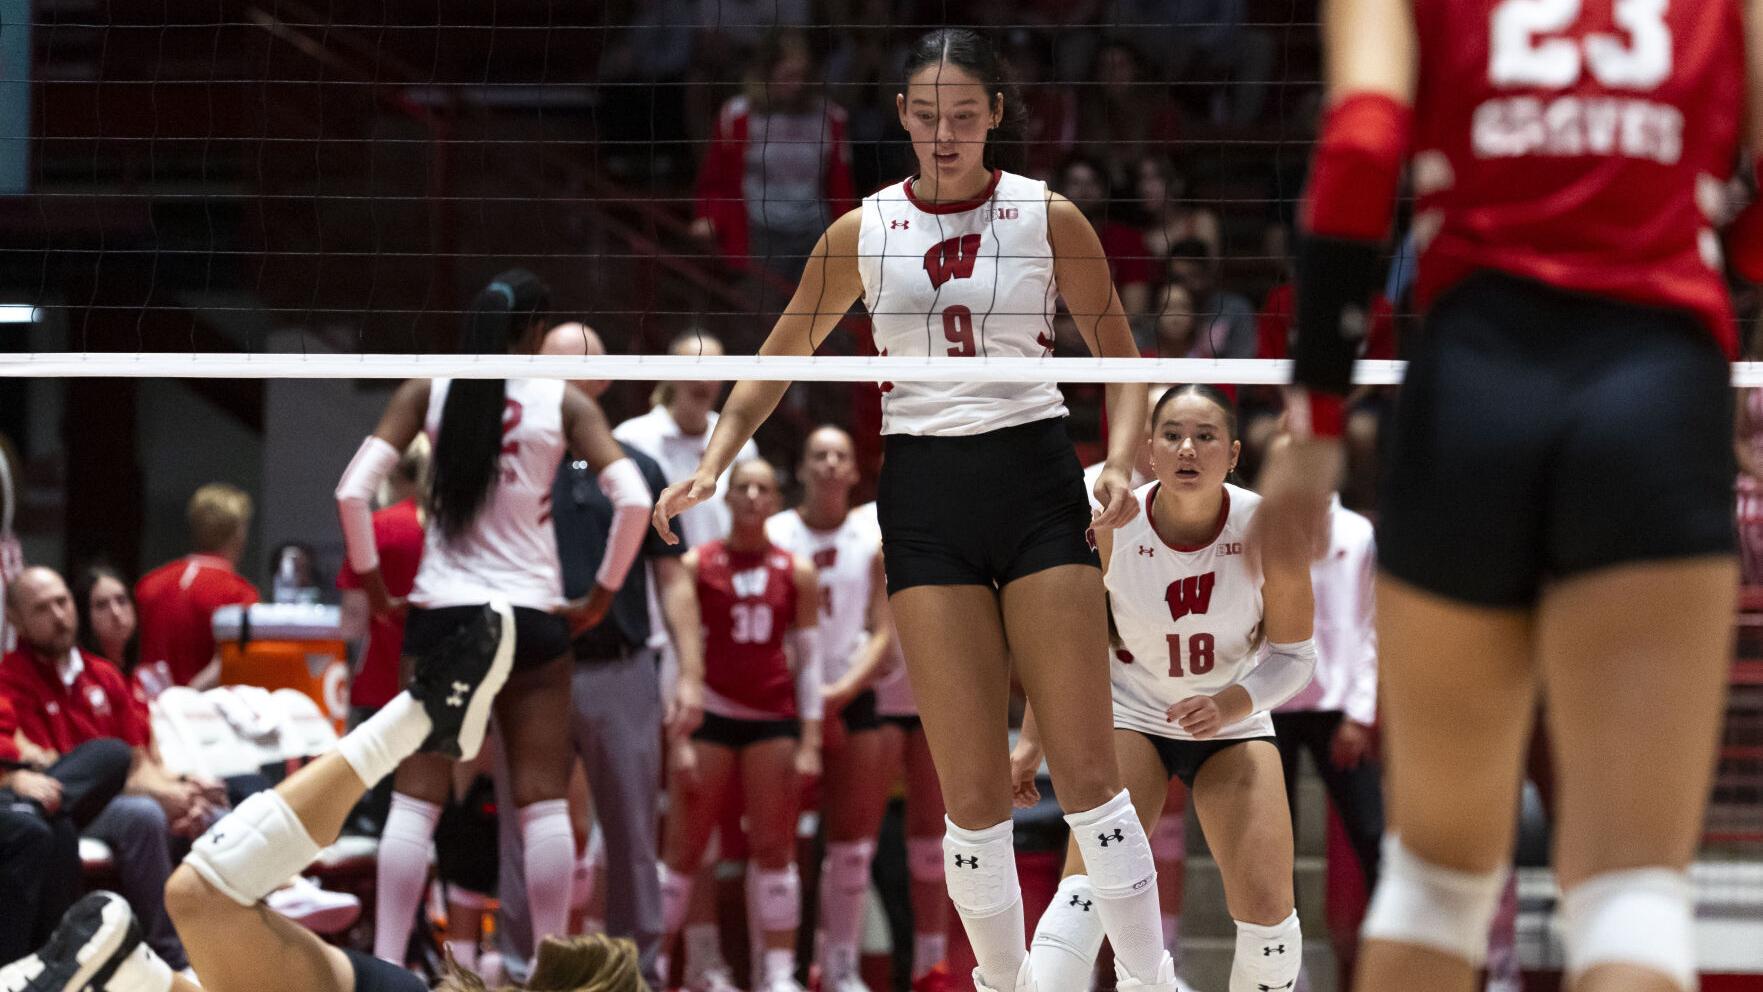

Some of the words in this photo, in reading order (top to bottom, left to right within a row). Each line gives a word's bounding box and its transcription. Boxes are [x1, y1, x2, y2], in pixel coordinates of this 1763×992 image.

[1487, 0, 1674, 90] 23
[923, 234, 981, 291] W
[943, 305, 976, 357] 9
[1165, 571, 1215, 622] W
[730, 603, 772, 644] 30
[1166, 632, 1215, 677] 18
